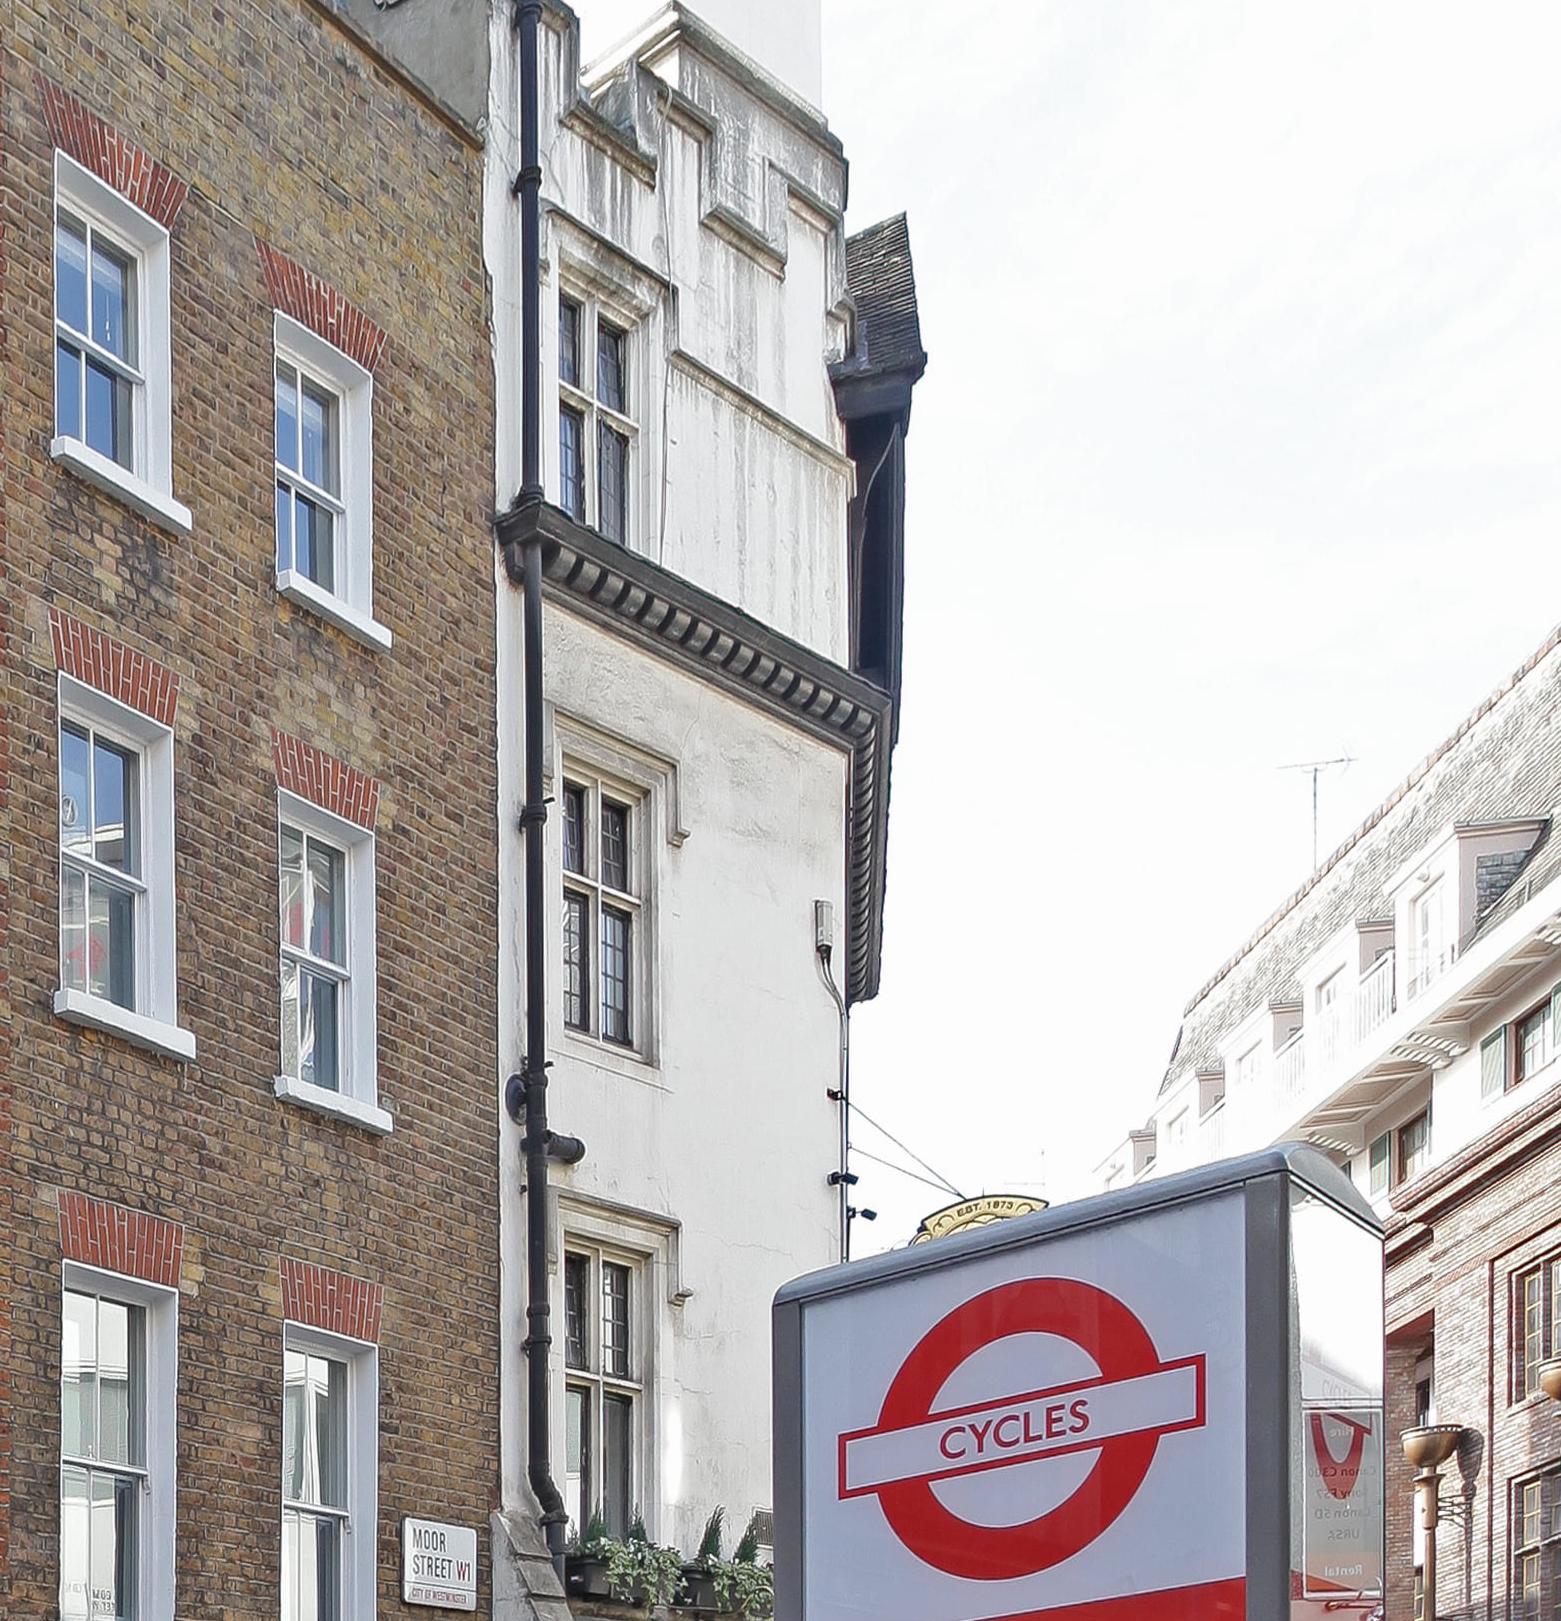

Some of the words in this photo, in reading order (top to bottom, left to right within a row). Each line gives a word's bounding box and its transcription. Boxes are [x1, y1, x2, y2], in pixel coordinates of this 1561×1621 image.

[987, 1200, 1014, 1210] 1873
[939, 1398, 1090, 1460] CYCLES
[412, 1527, 446, 1553] MOOR
[412, 1554, 453, 1580] STREET
[456, 1561, 470, 1582] W1
[412, 1587, 423, 1598] CITY
[432, 1590, 467, 1604] WESTMINSTER
